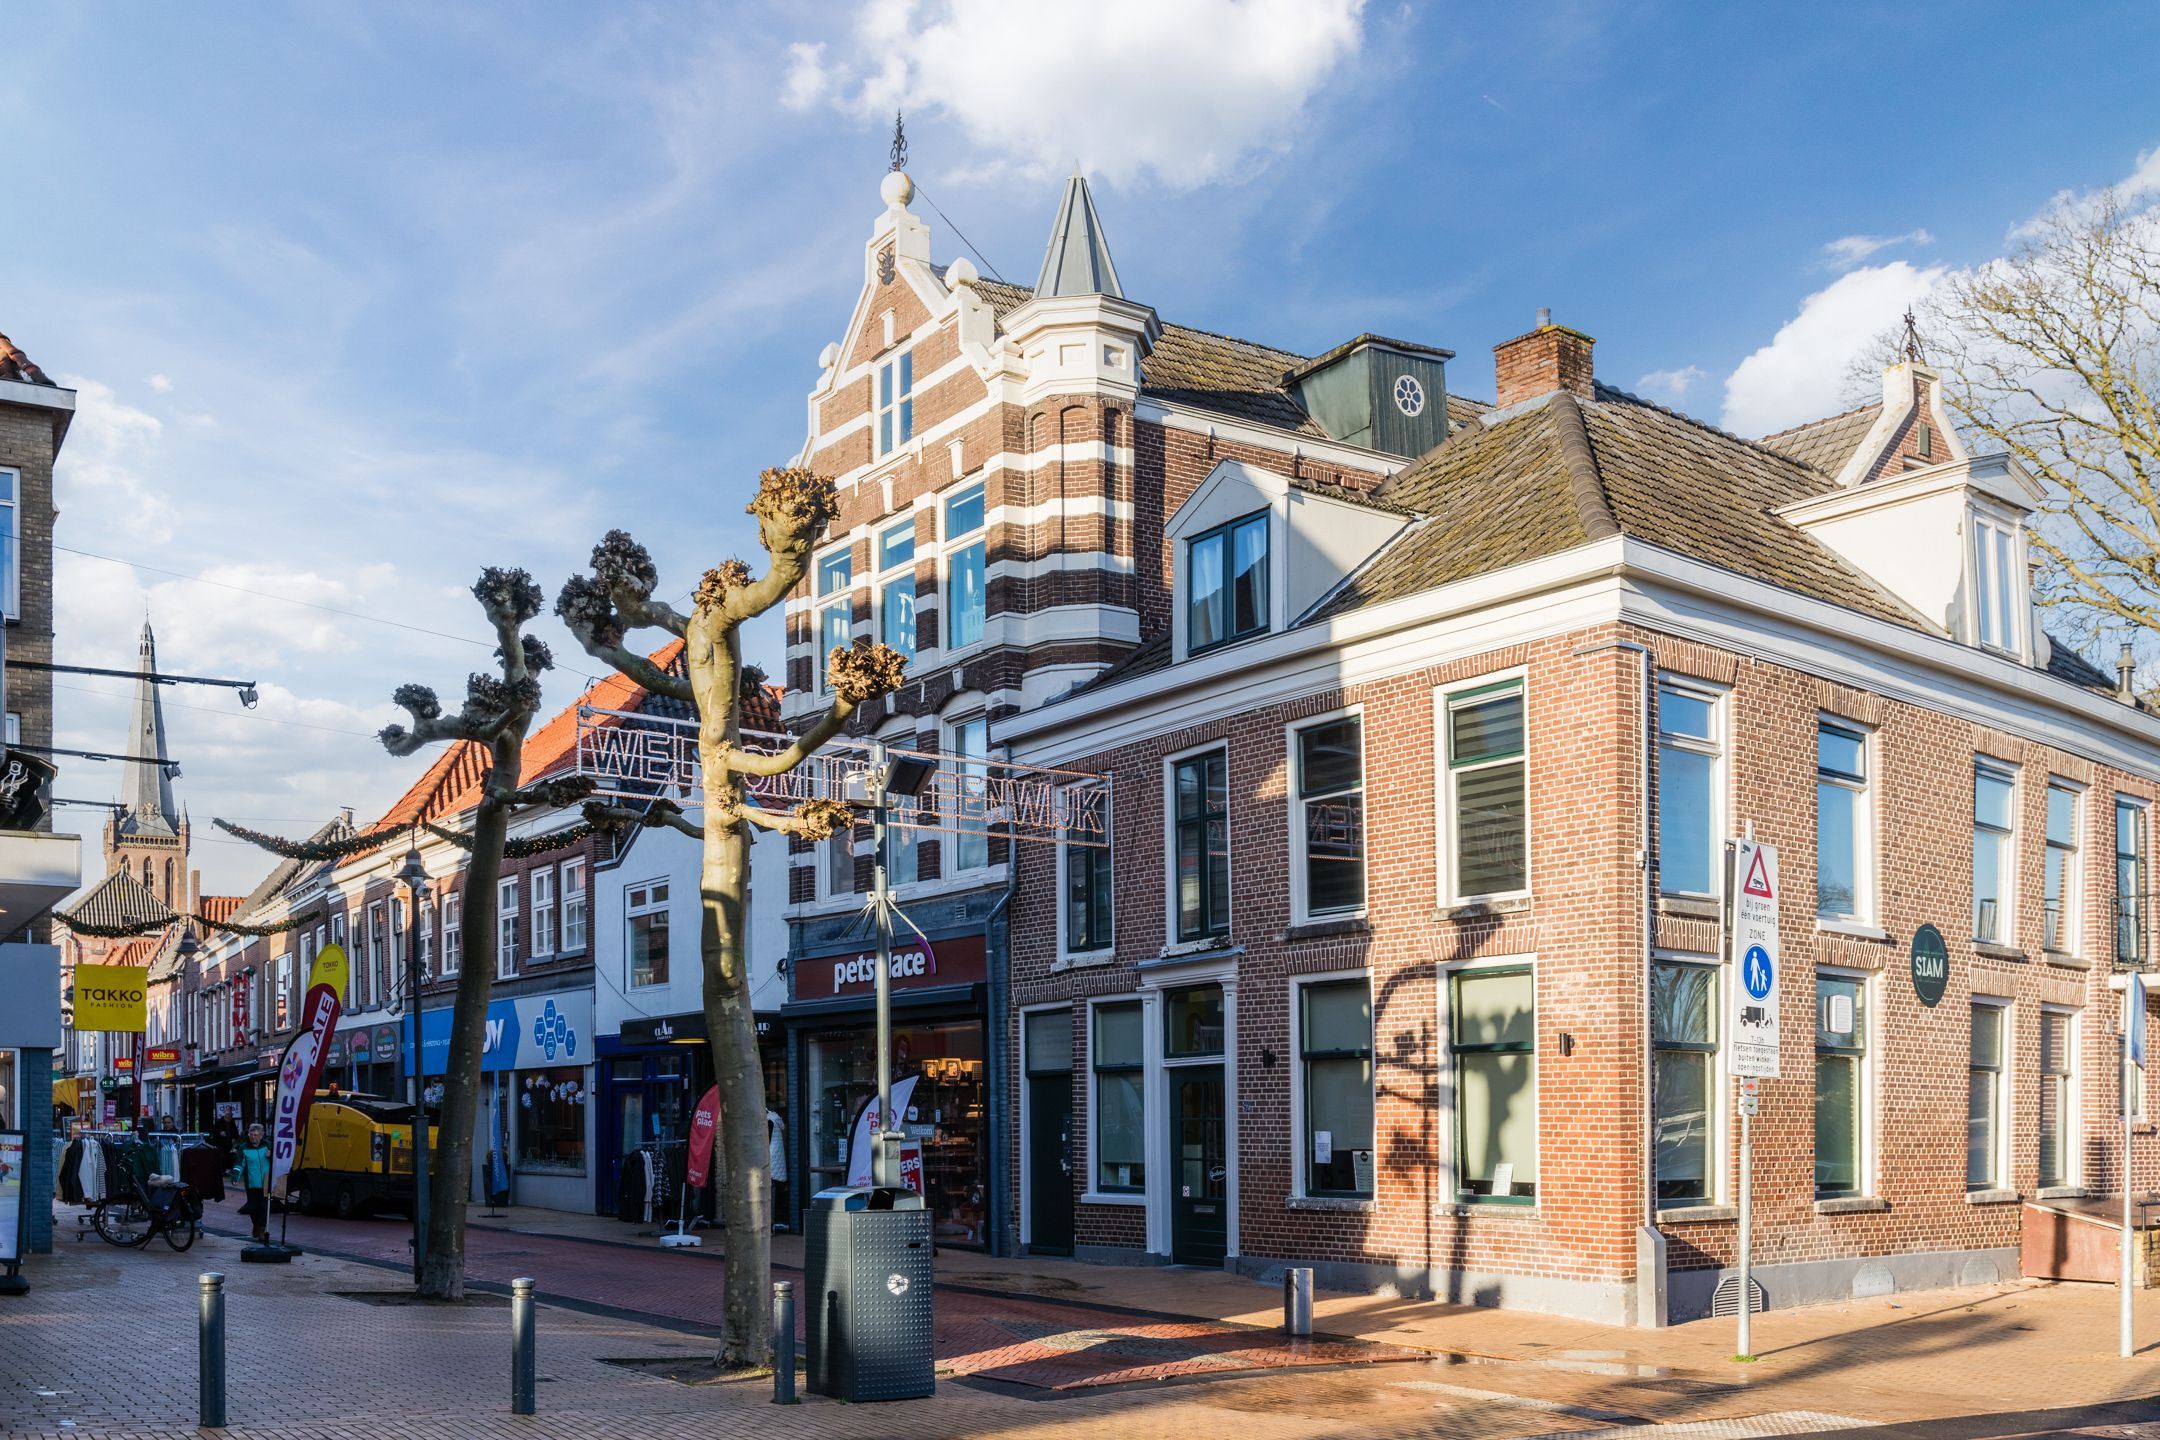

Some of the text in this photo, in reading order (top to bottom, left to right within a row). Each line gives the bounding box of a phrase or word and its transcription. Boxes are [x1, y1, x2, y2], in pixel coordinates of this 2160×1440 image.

[589, 727, 801, 799] WELOM
[1755, 902, 1770, 912] groen
[1753, 914, 1776, 927] voertuig
[1749, 929, 1766, 941] ZONE
[1915, 956, 1943, 979] SIAM
[233, 973, 248, 1046] HEMA
[276, 1095, 295, 1159] SNC
[910, 1125, 933, 1136] Welkom
[901, 1156, 920, 1174] ERS
